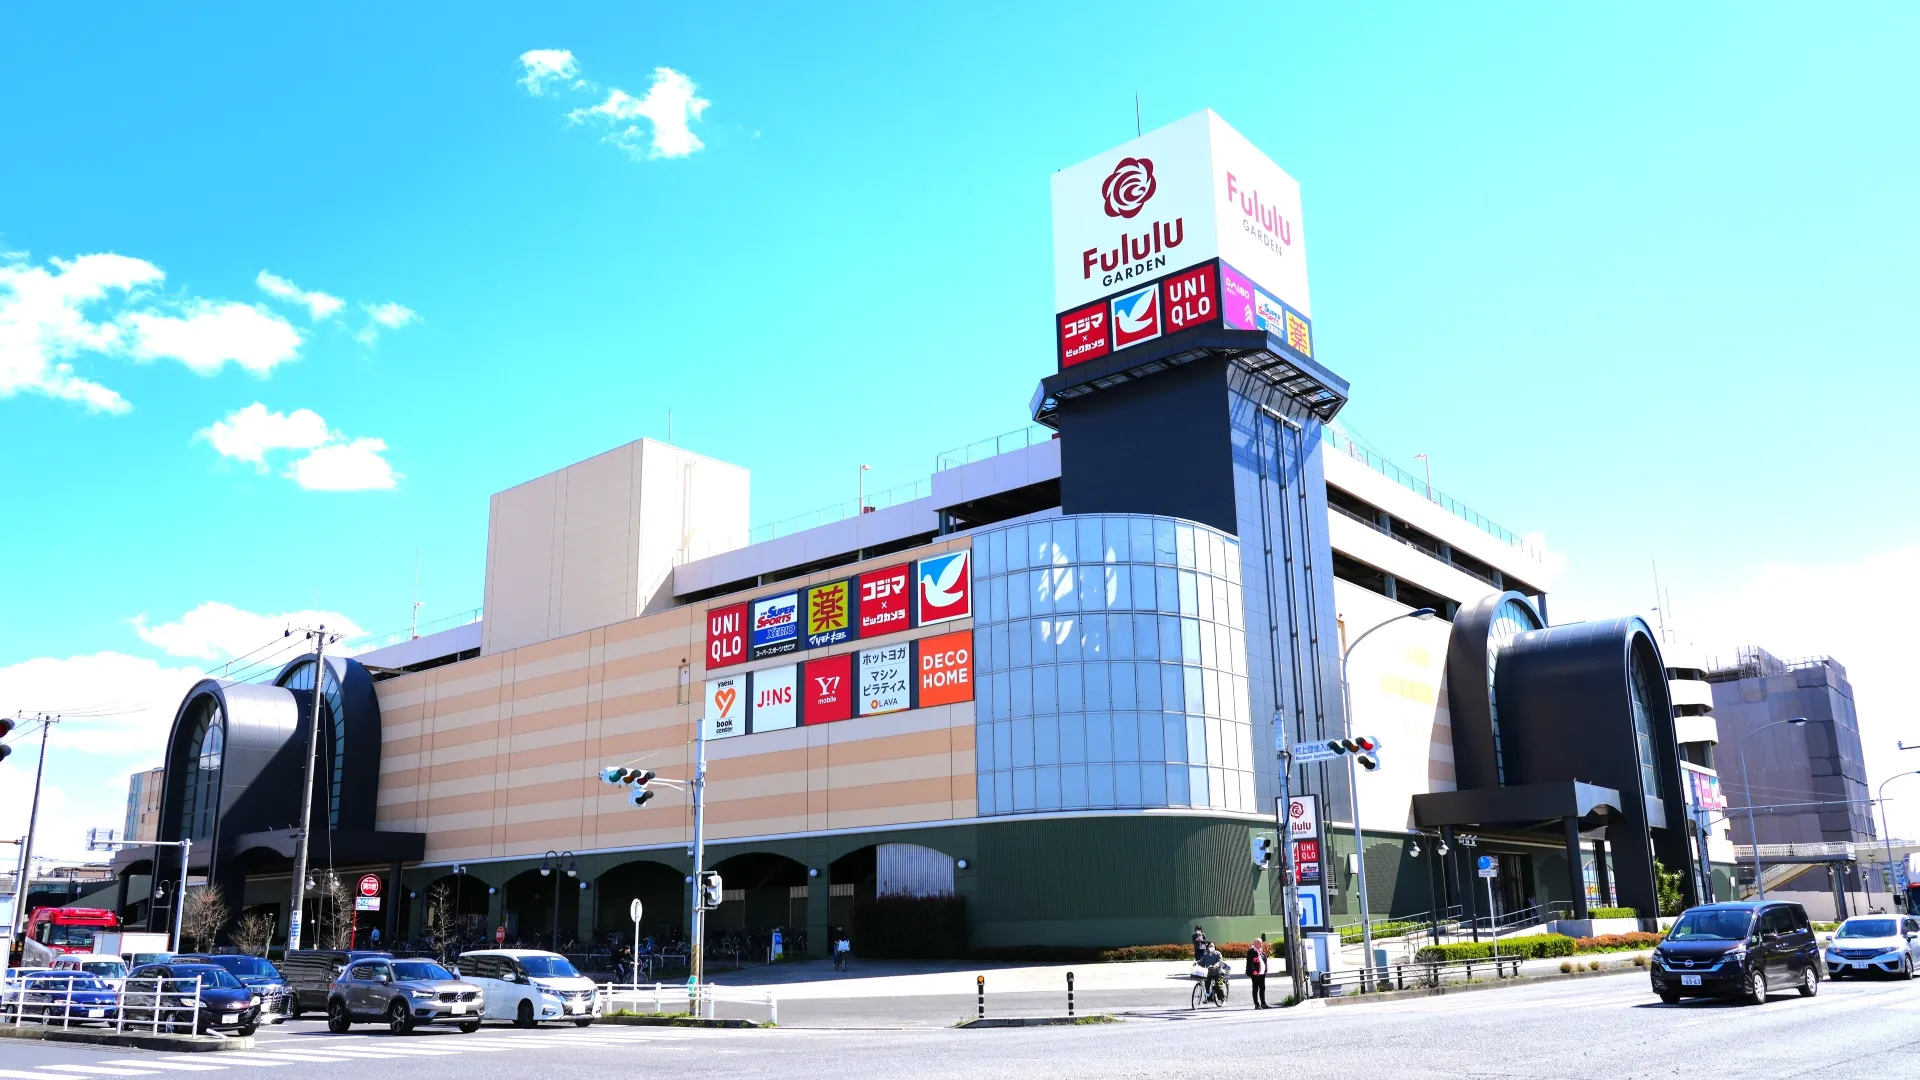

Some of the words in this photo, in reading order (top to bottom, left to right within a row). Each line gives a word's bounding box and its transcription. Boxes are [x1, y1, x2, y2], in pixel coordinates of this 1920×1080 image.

[1226, 171, 1291, 246] Fululu
[1083, 217, 1184, 280] Fululu
[1242, 218, 1283, 257] GARDEN
[1102, 255, 1166, 287] GARDEN
[1169, 274, 1206, 302] UNI
[1225, 277, 1250, 300] DAISO
[1171, 296, 1211, 327] QLO
[1064, 312, 1104, 339] コジマ
[1065, 338, 1105, 358] ビックカメラ
[862, 574, 906, 602] コジマ
[767, 605, 795, 618] SUPER
[812, 585, 844, 632] 薬
[862, 609, 906, 627] ビックカメラ
[712, 612, 739, 636] UNI
[756, 613, 792, 629] SPORTS
[711, 635, 742, 662] QLO
[862, 646, 907, 666] ホットヨガ
[923, 648, 968, 671] DECO
[870, 668, 898, 682] マシン
[923, 668, 969, 689] HOME
[863, 679, 906, 697] ピラティス
[817, 695, 837, 705] mobile
[879, 698, 898, 708] LAVA
[716, 719, 733, 728] book
[1301, 844, 1314, 852] UNI
[1301, 851, 1316, 860] QLO
